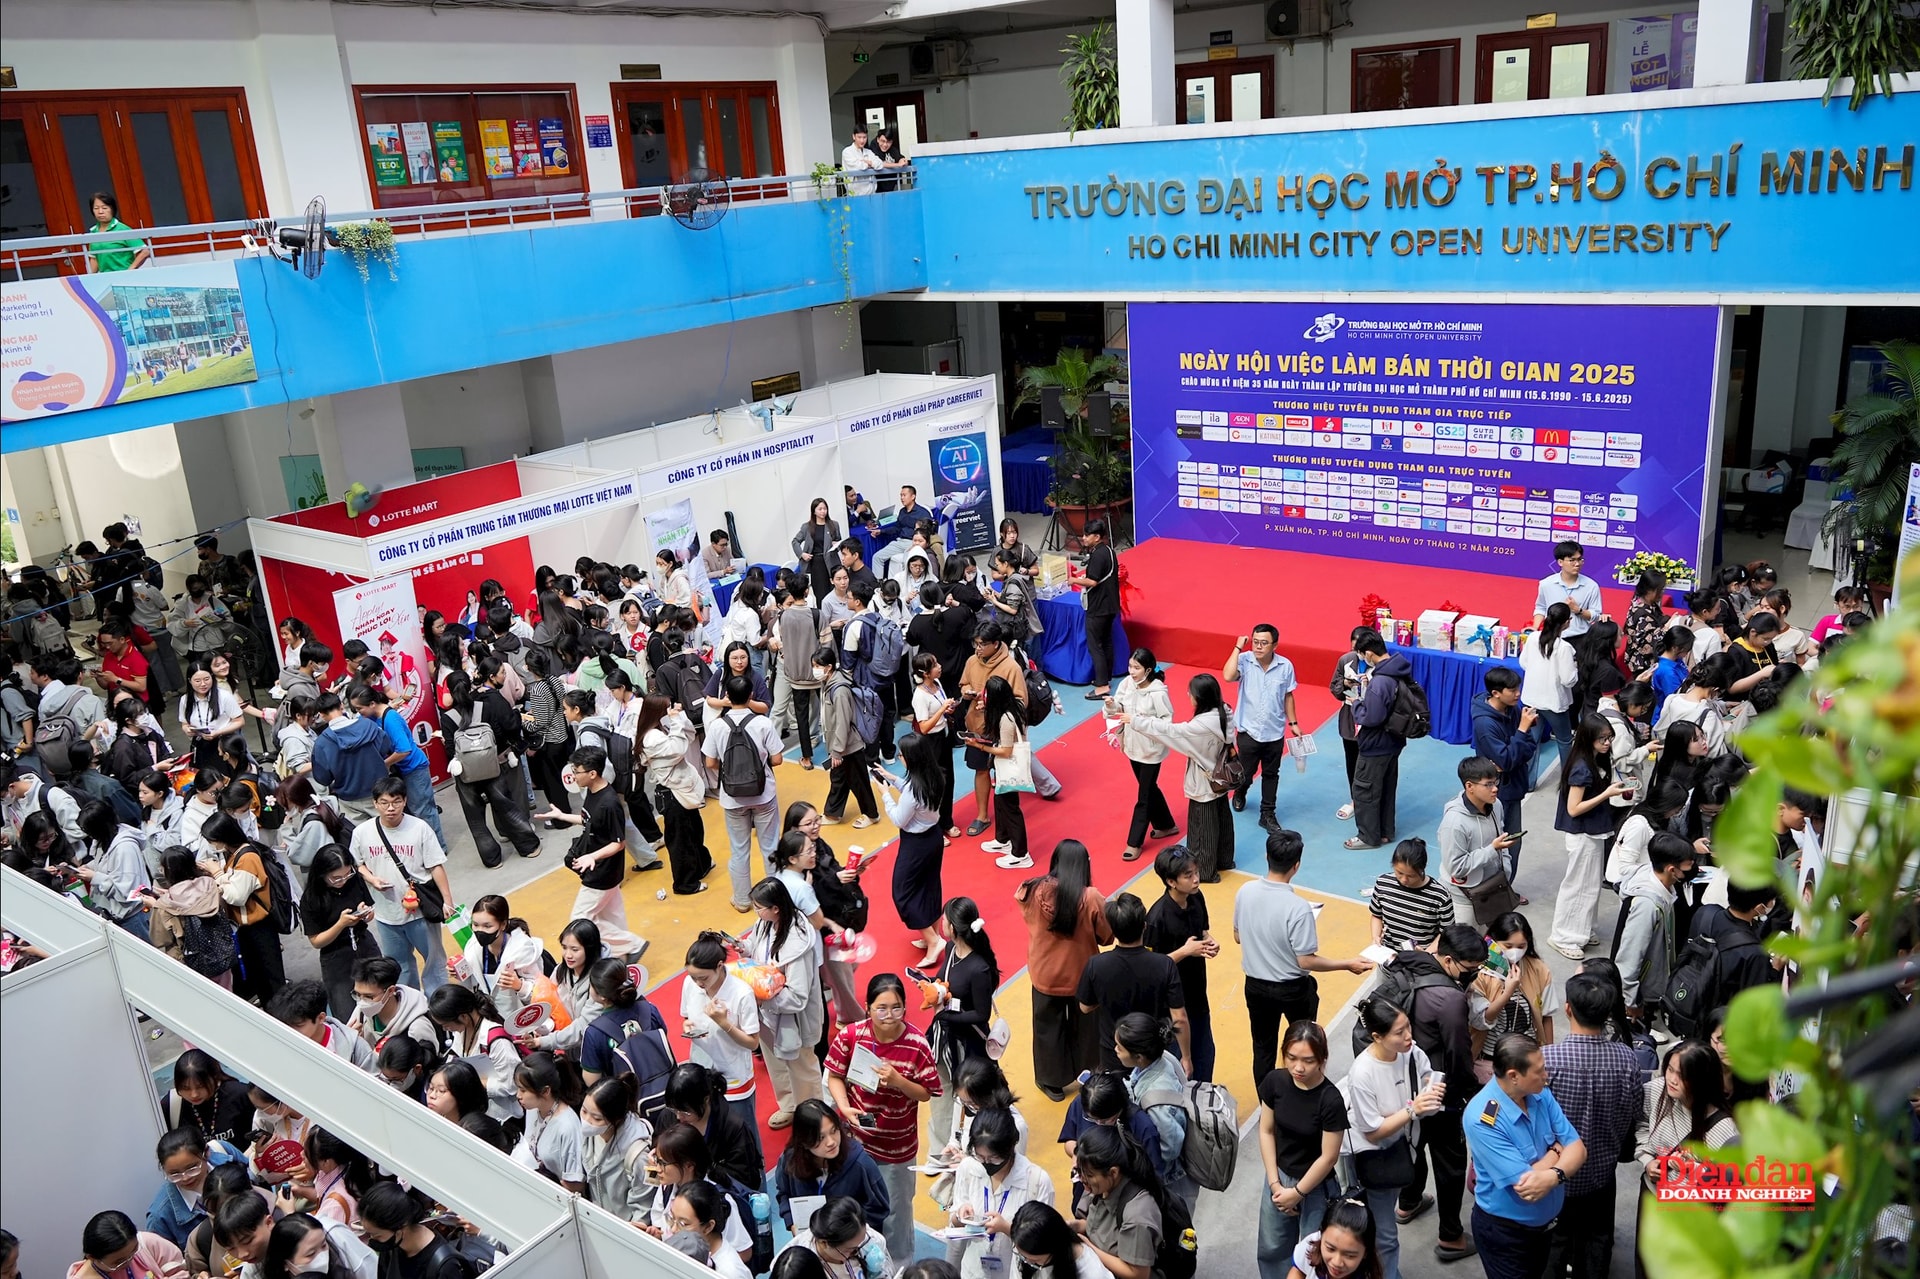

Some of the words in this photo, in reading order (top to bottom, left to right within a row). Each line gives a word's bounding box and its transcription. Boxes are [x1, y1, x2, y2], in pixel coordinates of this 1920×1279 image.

[1633, 40, 1649, 56] LỄ
[378, 161, 400, 170] TESOL
[1024, 173, 1185, 218] TRƯỜNG
[1196, 177, 1262, 220] ĐẠI
[1276, 172, 1369, 218] HỌC
[1384, 158, 1462, 208] MỞ
[1476, 149, 1627, 204] TP.HỒ
[1644, 142, 1743, 199] CHÍ
[1759, 144, 1915, 194] MINH
[1129, 234, 1166, 259] HO
[1173, 233, 1220, 258] CHI
[1230, 231, 1299, 258] MINH
[1309, 229, 1380, 256] CITY
[1390, 226, 1484, 256] OPEN
[1502, 221, 1731, 253] UNIVERSITY
[1348, 320, 1378, 330] TRƯỜNG
[1379, 321, 1392, 331] ĐẠI
[1392, 322, 1408, 331] HỌC
[1409, 320, 1422, 330] MỞ
[1423, 322, 1434, 330] TP.
[1434, 320, 1446, 330] HỒ
[1447, 322, 1460, 331] CHÍ
[1462, 323, 1482, 332] MINH
[19, 334, 38, 344] MẠI
[1179, 350, 1229, 370] NGÀY
[1236, 350, 1270, 374] HỘI
[1277, 351, 1325, 376] VIỆC
[1332, 352, 1376, 375] LÀM
[1384, 354, 1430, 378] BÁN
[1438, 356, 1492, 380] THỜI
[1500, 362, 1561, 382] GIAN
[1570, 364, 1636, 385] 2025
[1181, 376, 1198, 386] CHÀO
[1200, 376, 1220, 387] MỪNG
[1222, 376, 1230, 387] KỲ
[1233, 378, 1250, 389] NIỆM
[1252, 380, 1262, 388] 35
[1264, 379, 1279, 389] NĂM
[1282, 380, 1300, 390] NGÀY
[1302, 380, 1325, 390] THÀNH
[1328, 381, 1340, 392] LẬP
[1344, 382, 1372, 392] TRƯỜNG
[1375, 383, 1388, 394] ĐẠI
[1390, 384, 1405, 394] HỌC
[1407, 383, 1420, 394] MỞ
[1423, 385, 1448, 396] THÀNH
[1450, 386, 1466, 396] PHỐ
[1469, 386, 1480, 397] HỒ
[1483, 387, 1497, 398] CHÍ
[1500, 388, 1522, 398] MINH
[1524, 390, 1572, 401] (15.6.1990
[1582, 392, 1632, 404] 15.6.2025)
[850, 420, 872, 434] CÔNG
[872, 417, 881, 428] TY
[882, 412, 892, 424] CỔ
[893, 407, 912, 421] PHẦN
[913, 402, 927, 416] GIẢI
[928, 397, 946, 411] PHÁP
[946, 390, 984, 406] CAREERVIET
[1272, 400, 1310, 410] THƯƠNG
[1312, 402, 1336, 412] HIỆU
[1338, 401, 1370, 412] TUYỂN
[1372, 404, 1399, 415] DỤNG
[1402, 406, 1432, 416] THAM
[1434, 408, 1453, 417] GIA
[1456, 409, 1484, 420] TRỰC
[1488, 410, 1512, 420] TIẾP
[1210, 413, 1220, 423] ila
[938, 420, 973, 433] careerviet
[1436, 426, 1465, 436] GS25
[668, 467, 697, 484] CÔNG
[698, 464, 710, 476] TY
[710, 457, 724, 472] CỔ
[725, 450, 750, 468] PHẦN
[750, 448, 762, 461] IN
[763, 435, 815, 456] HOSPITALITY
[952, 449, 966, 462] AI
[1272, 454, 1308, 464] THƯƠNG
[1310, 456, 1332, 467] HIỆU
[1335, 456, 1364, 468] TUYỂN
[1368, 460, 1394, 471] DỤNG
[1397, 462, 1425, 472] THAM
[1428, 465, 1446, 474] GIA
[1448, 466, 1475, 478] TRỰC
[1478, 468, 1512, 479] TUYẾN
[382, 509, 412, 522] LOTTE
[412, 500, 438, 514] MART
[1584, 506, 1605, 514] CPA
[378, 545, 408, 562] CÔNG
[408, 541, 420, 555] TY
[422, 534, 436, 550] CỔ
[437, 528, 464, 546] PHẦN
[465, 522, 497, 538] TRUNG
[497, 514, 517, 530] TÂM
[519, 506, 552, 524] THƯƠNG
[553, 502, 570, 520] MẠI
[570, 494, 596, 510] LOTTE
[596, 487, 614, 504] VIỆT
[614, 482, 633, 498] NAM
[1274, 522, 1296, 534] XUÂN
[1297, 524, 1315, 536] HÒA,
[1318, 528, 1330, 536] TP.
[1332, 528, 1343, 538] HỒ
[1346, 529, 1360, 540] CHÍ
[1362, 532, 1386, 544] MINH,
[1388, 533, 1411, 545] NGÀY
[1413, 538, 1424, 546] 07
[1426, 538, 1456, 550] THÁNG
[1458, 542, 1468, 550] 12
[1470, 542, 1490, 553] NĂM
[1493, 546, 1516, 556] 2025
[422, 563, 435, 575] SẼ
[436, 558, 458, 570] LÀM
[458, 552, 470, 564] GÌ
[364, 588, 380, 598] LOTTE
[382, 583, 396, 591] MART
[376, 608, 396, 621] NGAY
[369, 844, 414, 858] NOCRNAL
[269, 1145, 286, 1156] JOIN
[274, 1150, 289, 1161] OUR
[276, 1152, 297, 1167] TEAM!
